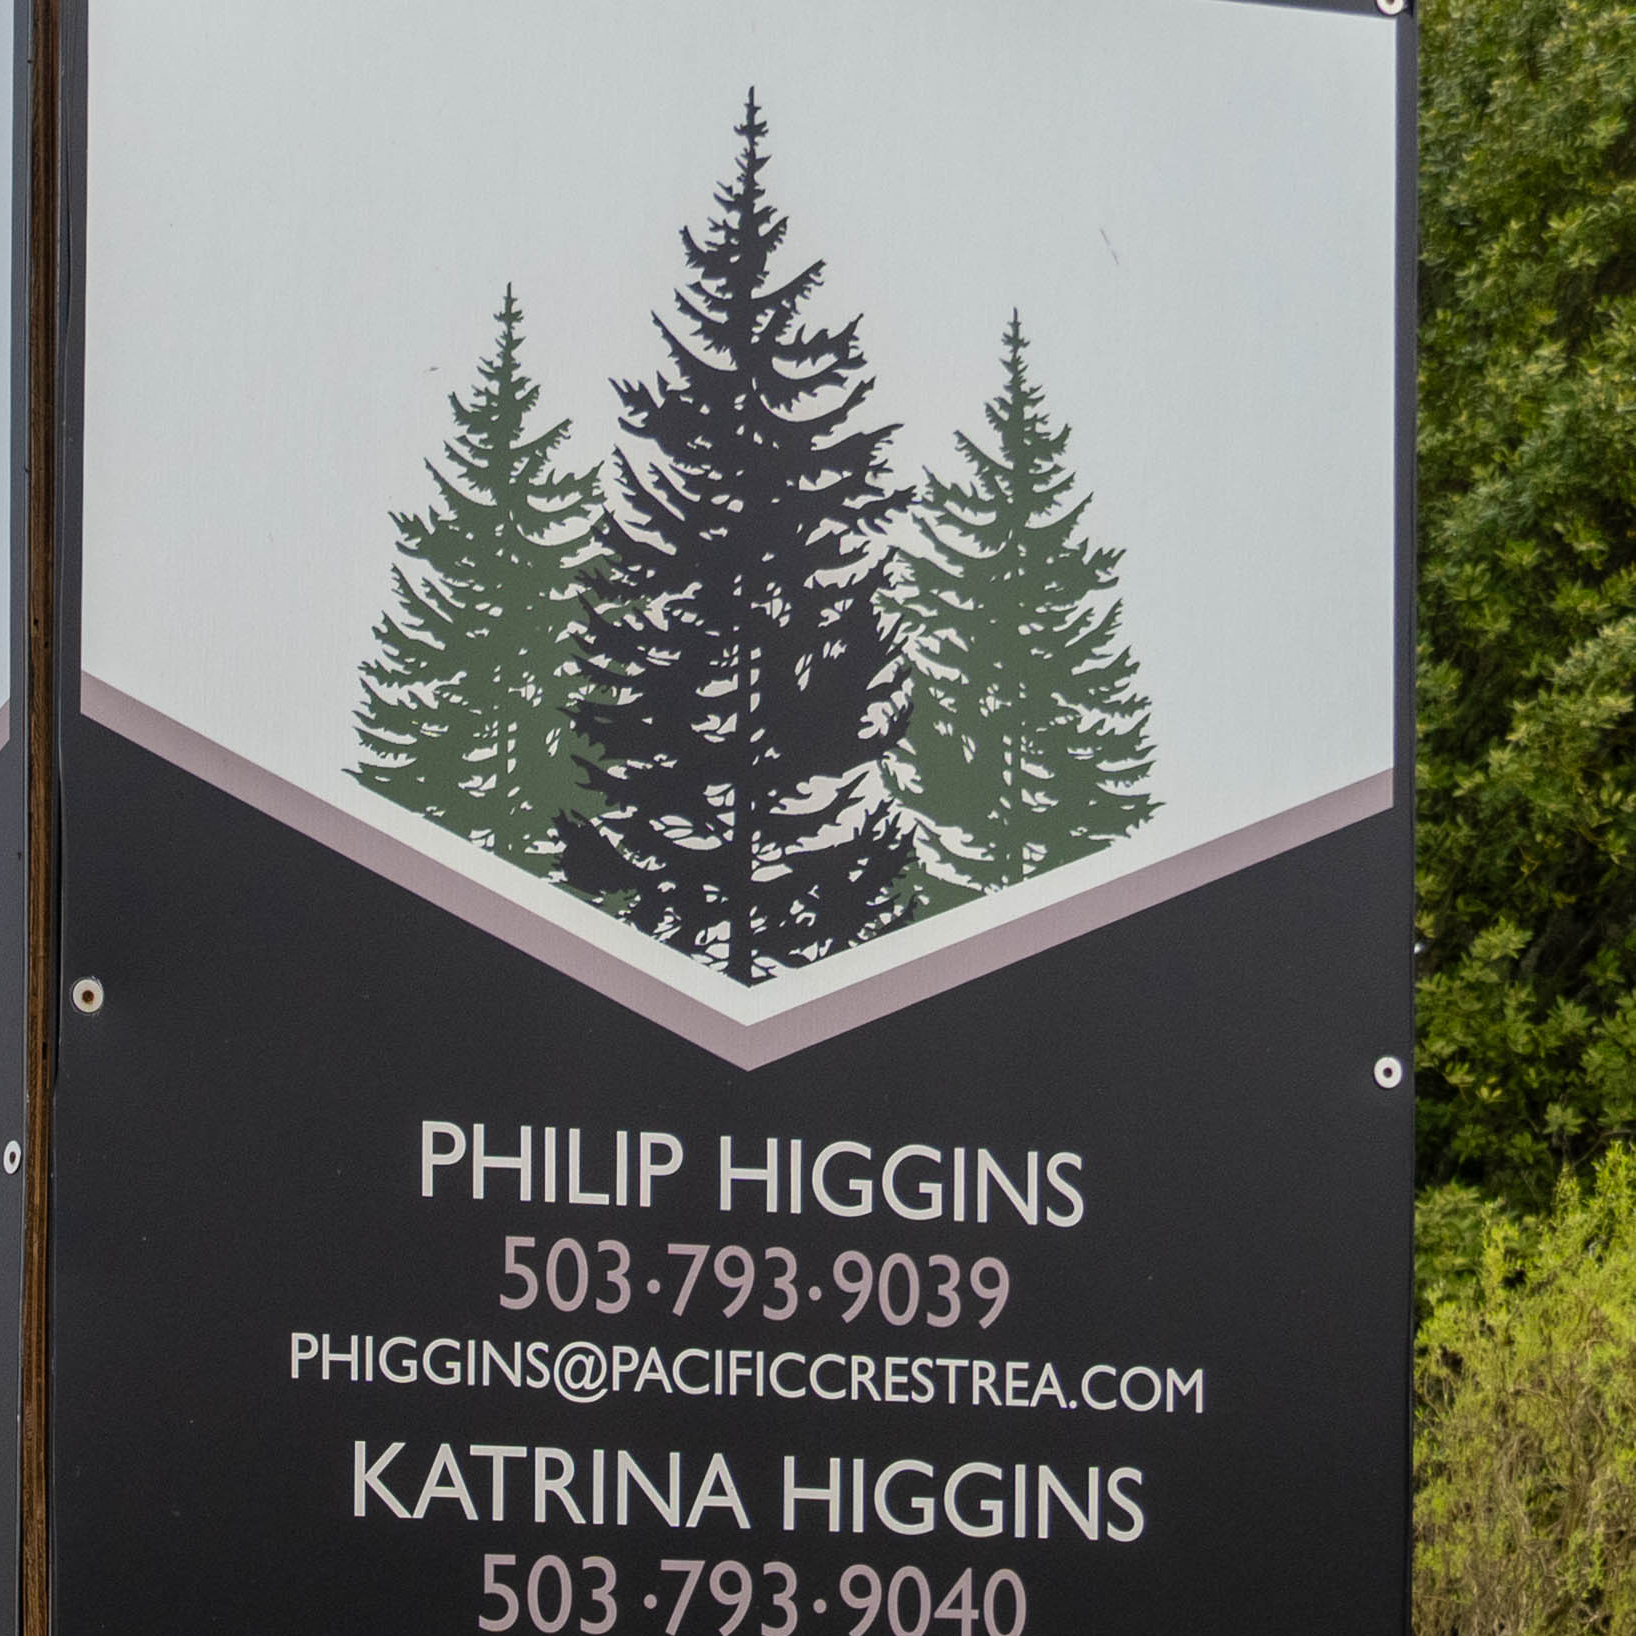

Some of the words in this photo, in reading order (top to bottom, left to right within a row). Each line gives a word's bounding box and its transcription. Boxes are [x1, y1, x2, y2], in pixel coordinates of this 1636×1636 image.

[422, 1120, 683, 1207] PHILIP
[720, 1136, 1084, 1227] HIGGINS
[291, 1332, 1203, 1413] PHIGGINS@PACIFICCRESTREA.COM
[354, 1440, 751, 1529] KATRINA
[783, 1456, 1144, 1542] HIGGINS
